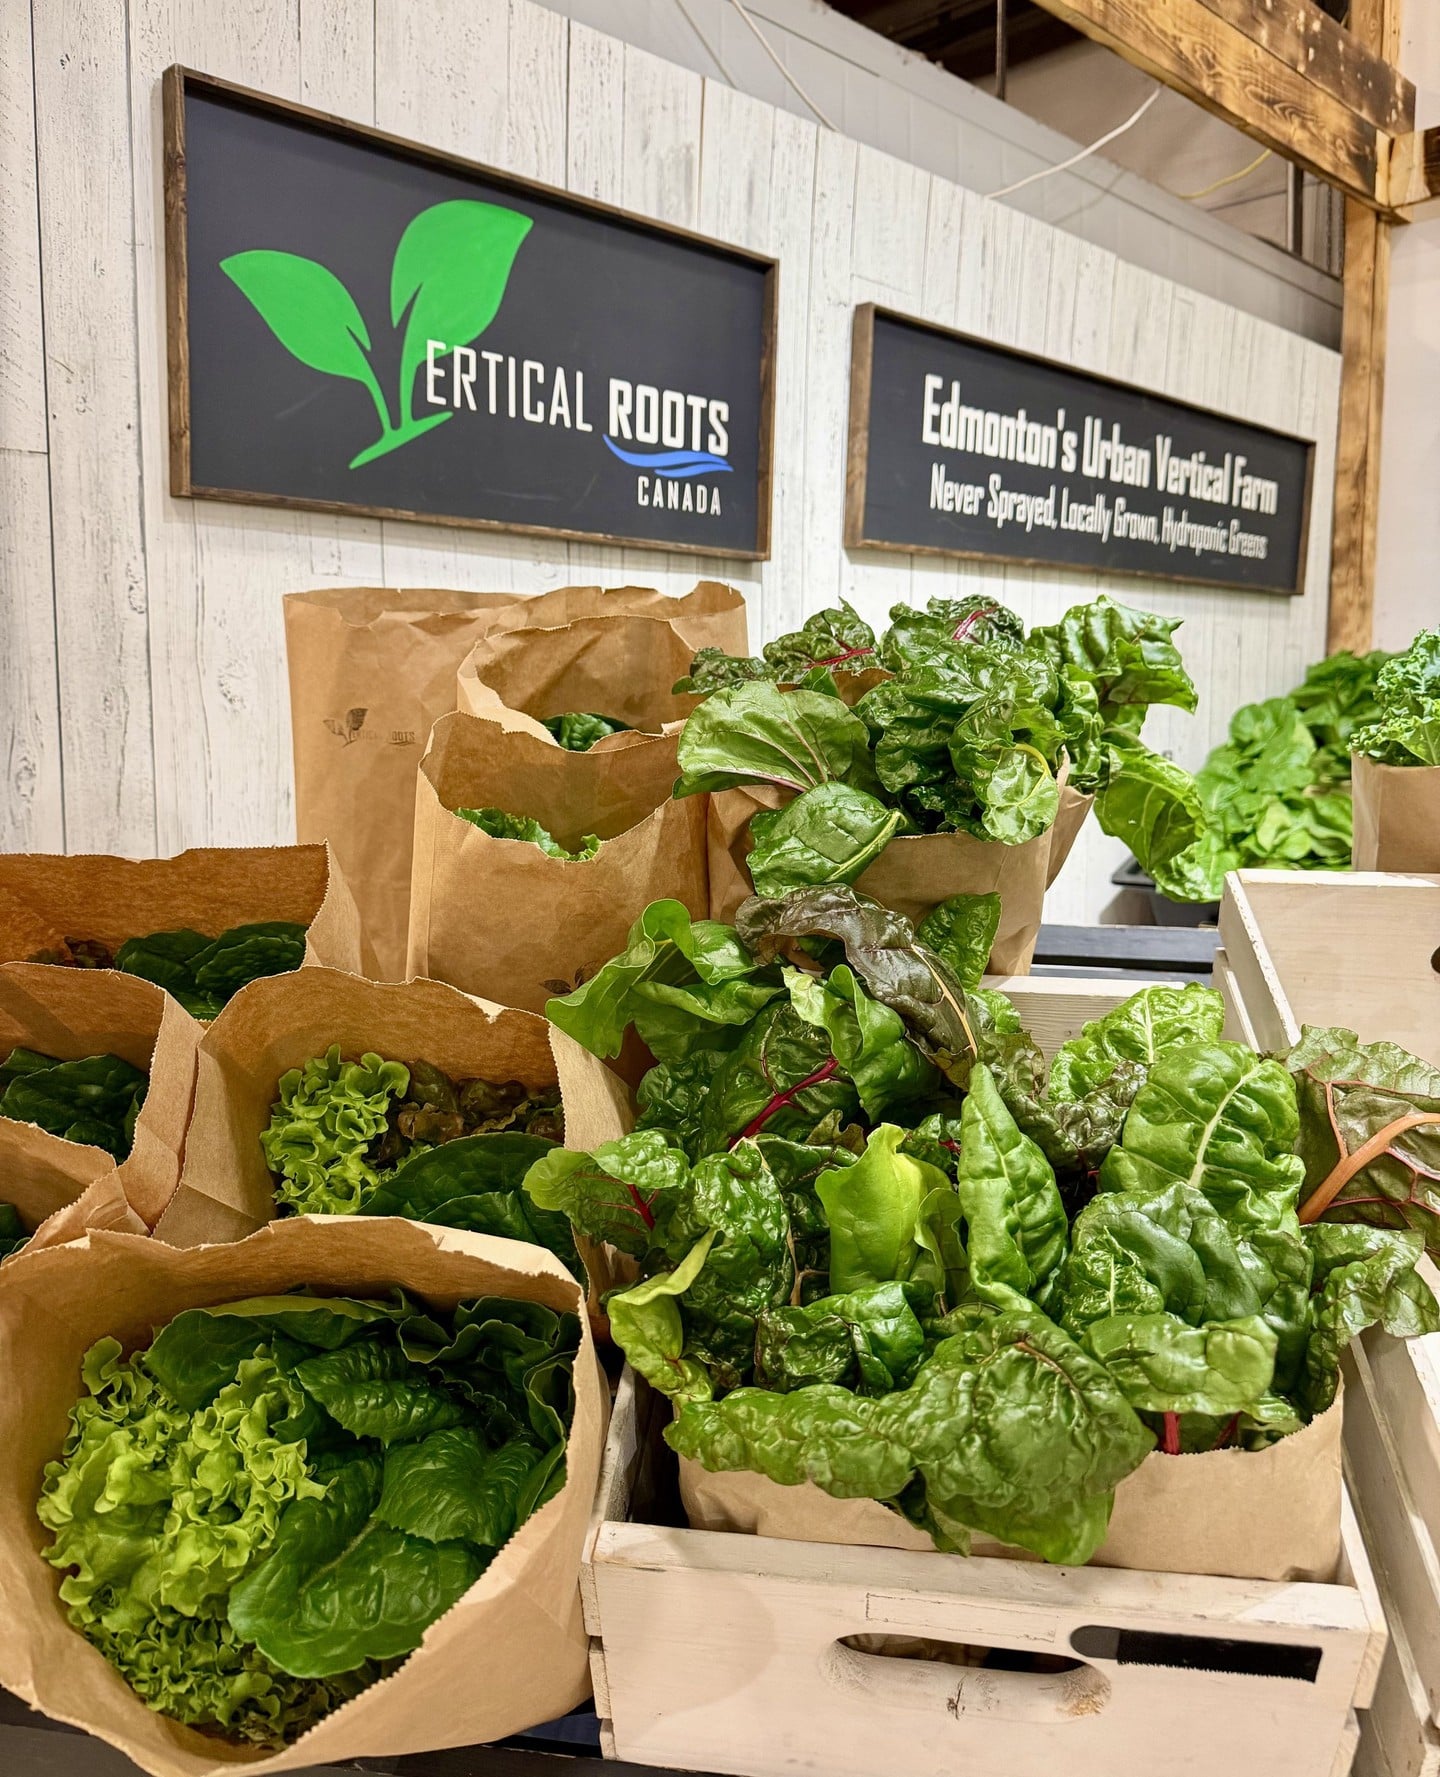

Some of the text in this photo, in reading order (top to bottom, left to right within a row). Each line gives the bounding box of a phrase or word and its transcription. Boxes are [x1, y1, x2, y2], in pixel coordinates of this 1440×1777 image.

[608, 378, 729, 456] ROOTS
[922, 373, 1278, 515] Edmonton's Urban Vertical Farm
[637, 475, 721, 516] CANADA
[930, 462, 1269, 560] Never Sprayed, Locally Grown, Hydroponic Greens
